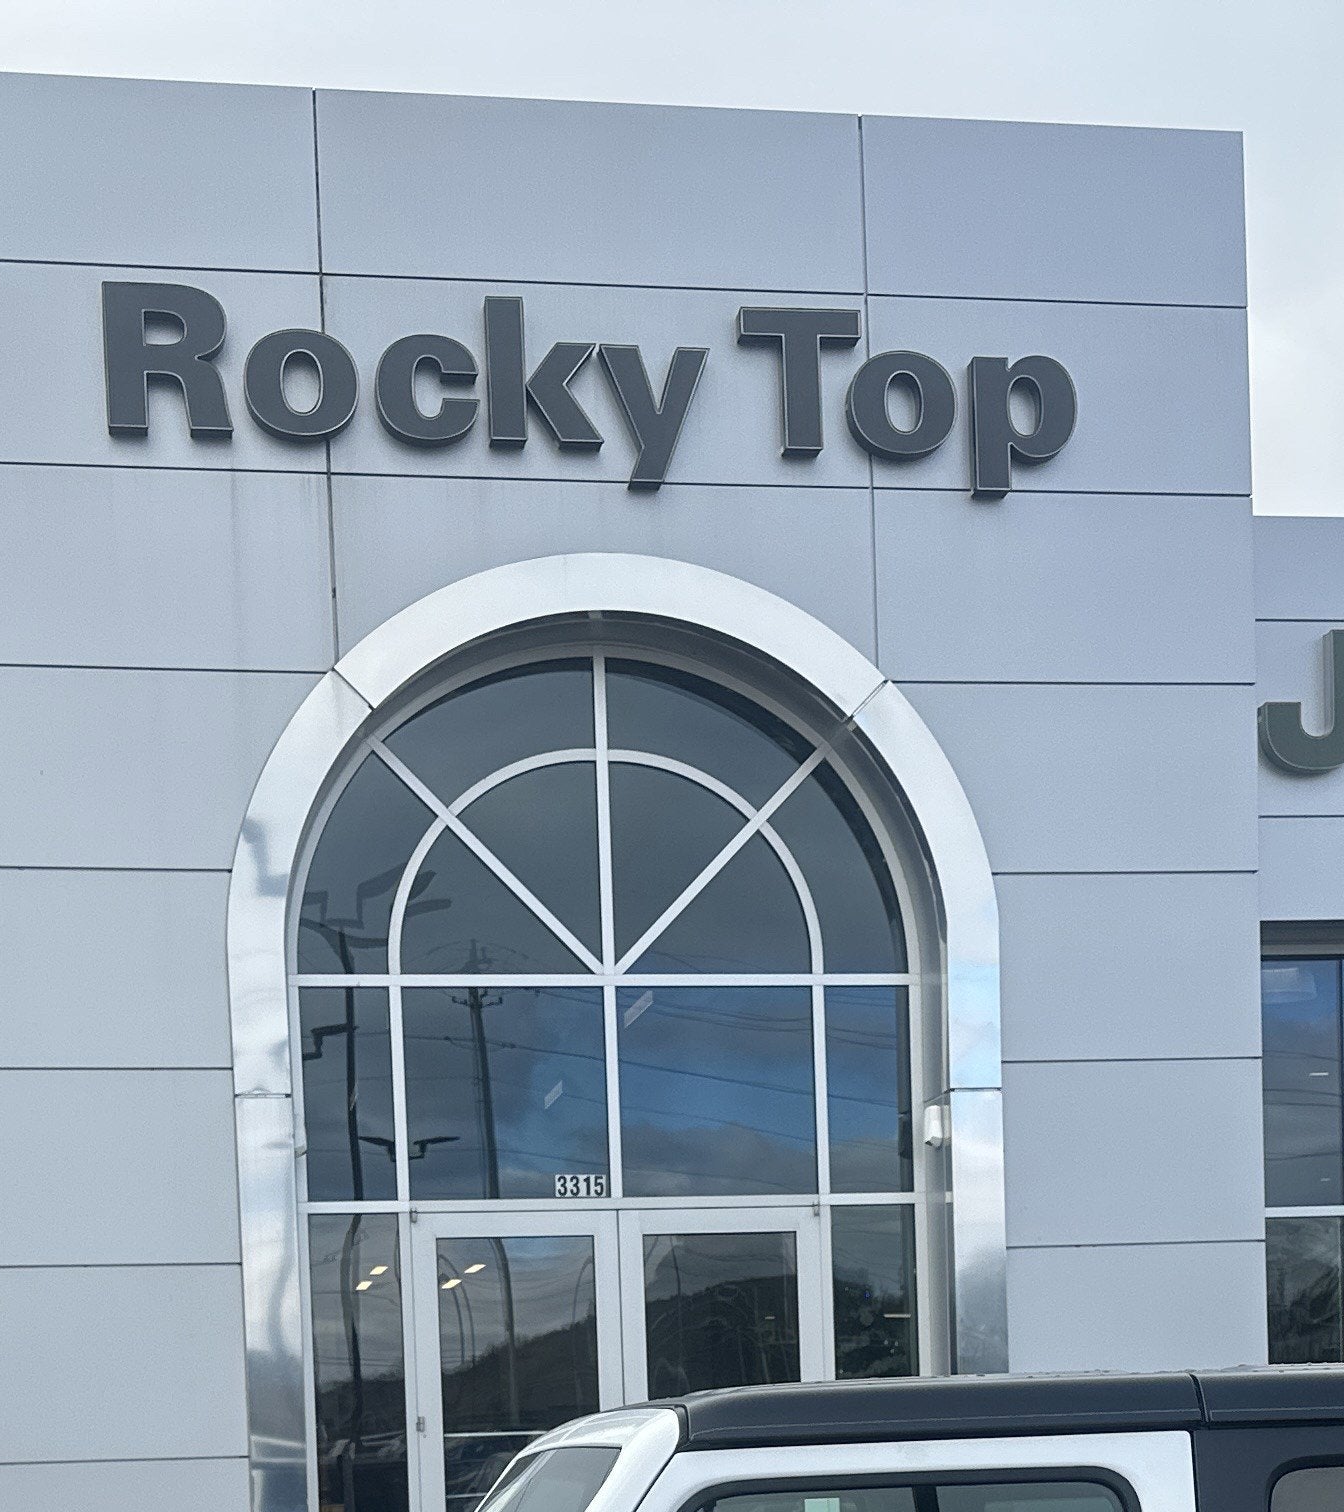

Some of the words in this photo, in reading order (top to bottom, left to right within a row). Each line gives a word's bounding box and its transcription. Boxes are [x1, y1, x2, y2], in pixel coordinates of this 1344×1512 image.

[100, 280, 711, 492] Rocky
[736, 305, 1080, 499] Top
[556, 1175, 605, 1197] 3315
